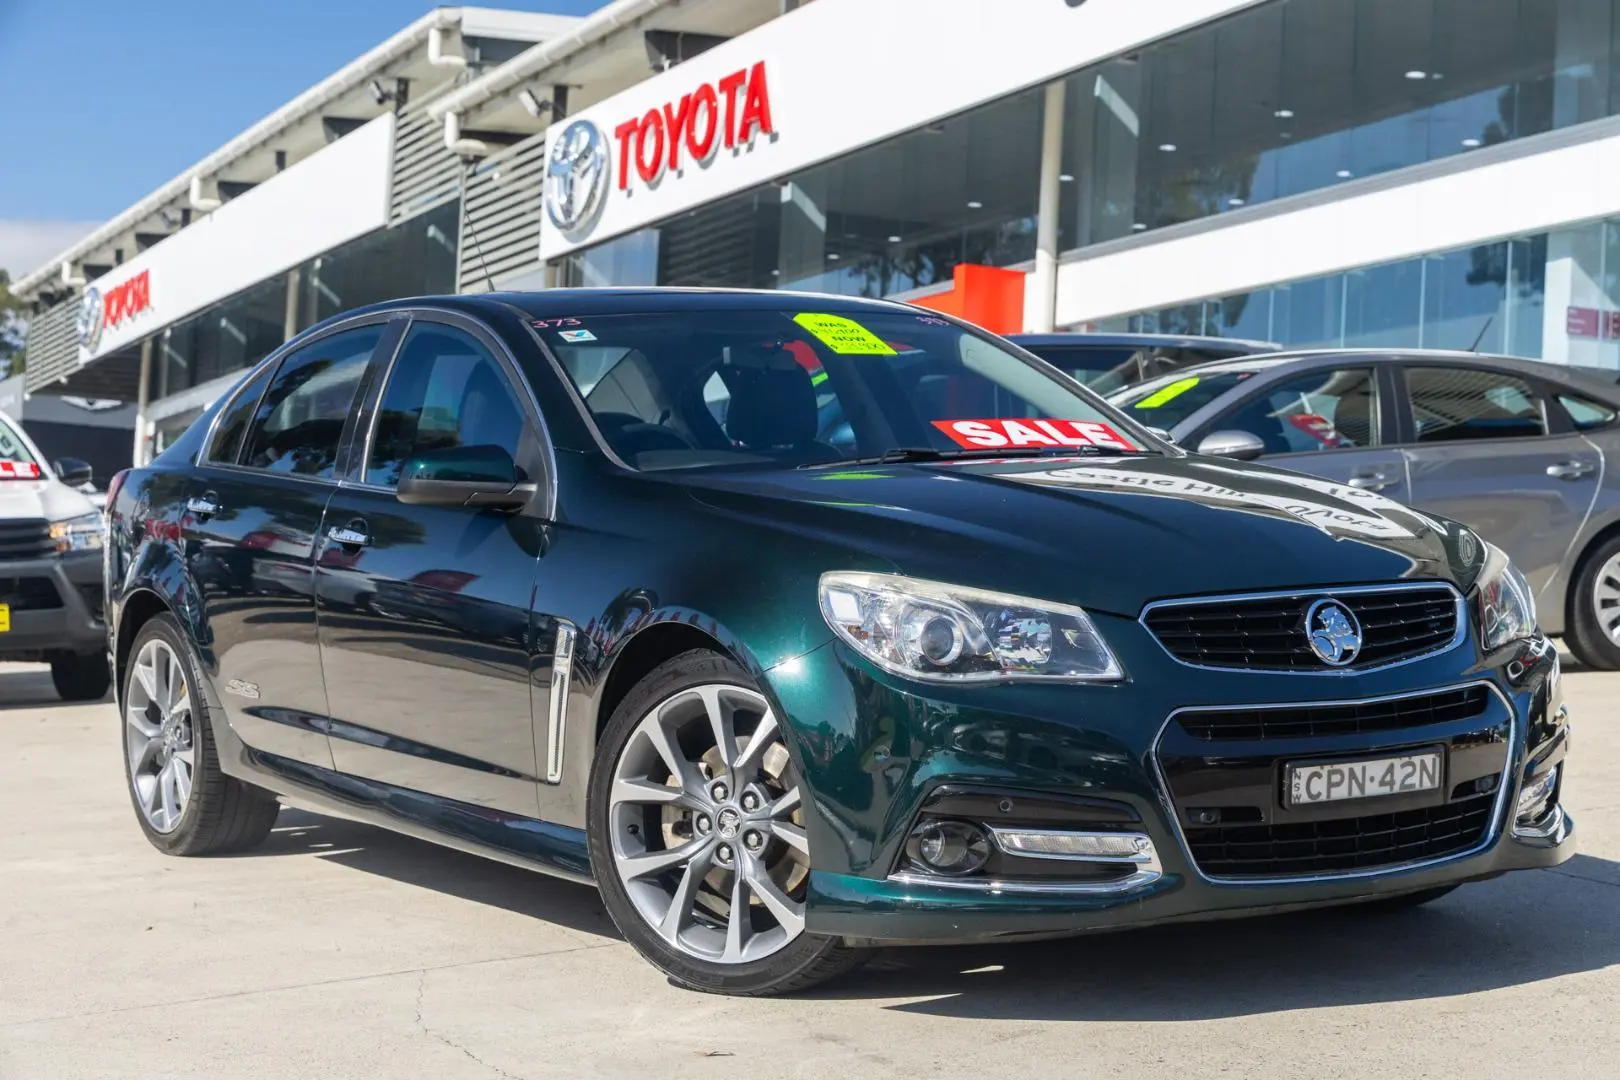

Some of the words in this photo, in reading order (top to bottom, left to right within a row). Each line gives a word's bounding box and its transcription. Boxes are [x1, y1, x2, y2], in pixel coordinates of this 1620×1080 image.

[614, 60, 773, 191] TOYOTA
[103, 268, 149, 329] TOYOTA
[531, 317, 581, 329] 373
[952, 420, 1129, 449] SALE
